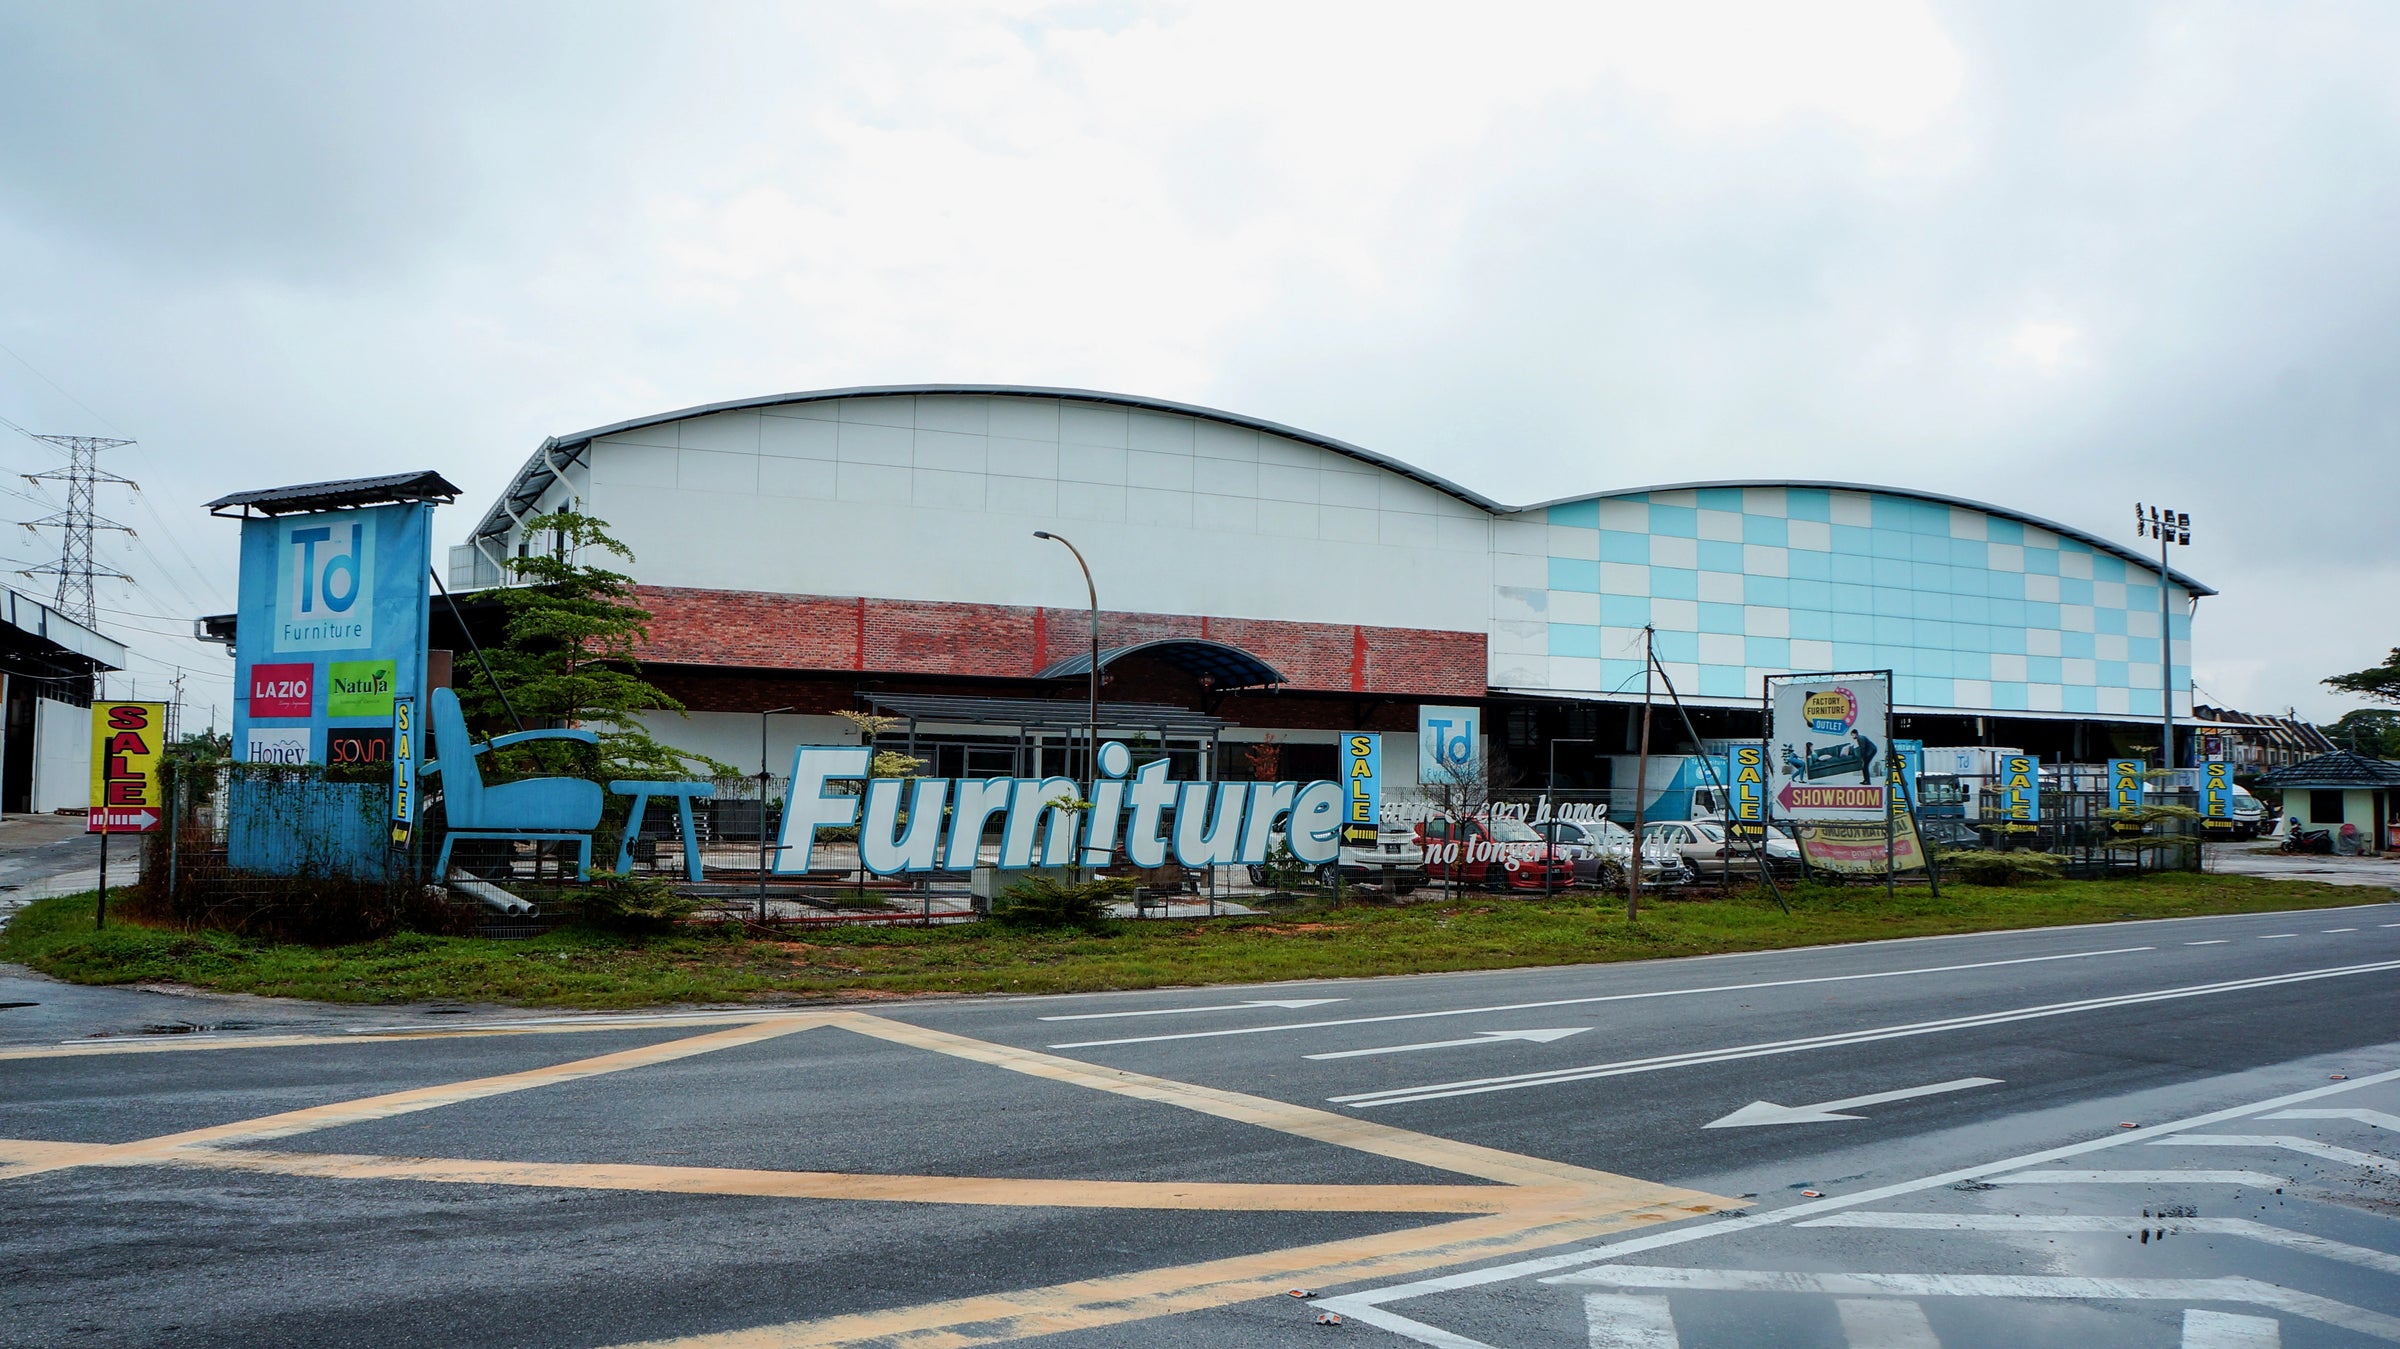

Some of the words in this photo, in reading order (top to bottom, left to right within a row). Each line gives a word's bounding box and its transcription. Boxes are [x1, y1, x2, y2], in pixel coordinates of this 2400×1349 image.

[291, 523, 362, 613] Td
[284, 622, 362, 640] Furniture
[256, 681, 307, 698] LAZIO
[1813, 697, 1840, 705] FACTORY
[1807, 706, 1844, 715] FURNITURE
[1816, 720, 1842, 731] OUTLET
[107, 706, 150, 805] SALE
[250, 741, 305, 765] Honey
[397, 704, 410, 818] SALE
[1428, 719, 1471, 765] Td
[1957, 756, 1970, 768] Td
[1351, 736, 1372, 822] SALE
[1738, 748, 1761, 819] SALE
[1792, 789, 1880, 806] SHOWROOM
[2010, 758, 2032, 819] SALE
[2207, 764, 2226, 816] SALE
[772, 741, 1343, 875] Furniture
[1424, 842, 1459, 864] no
[1466, 834, 1547, 871] longer
